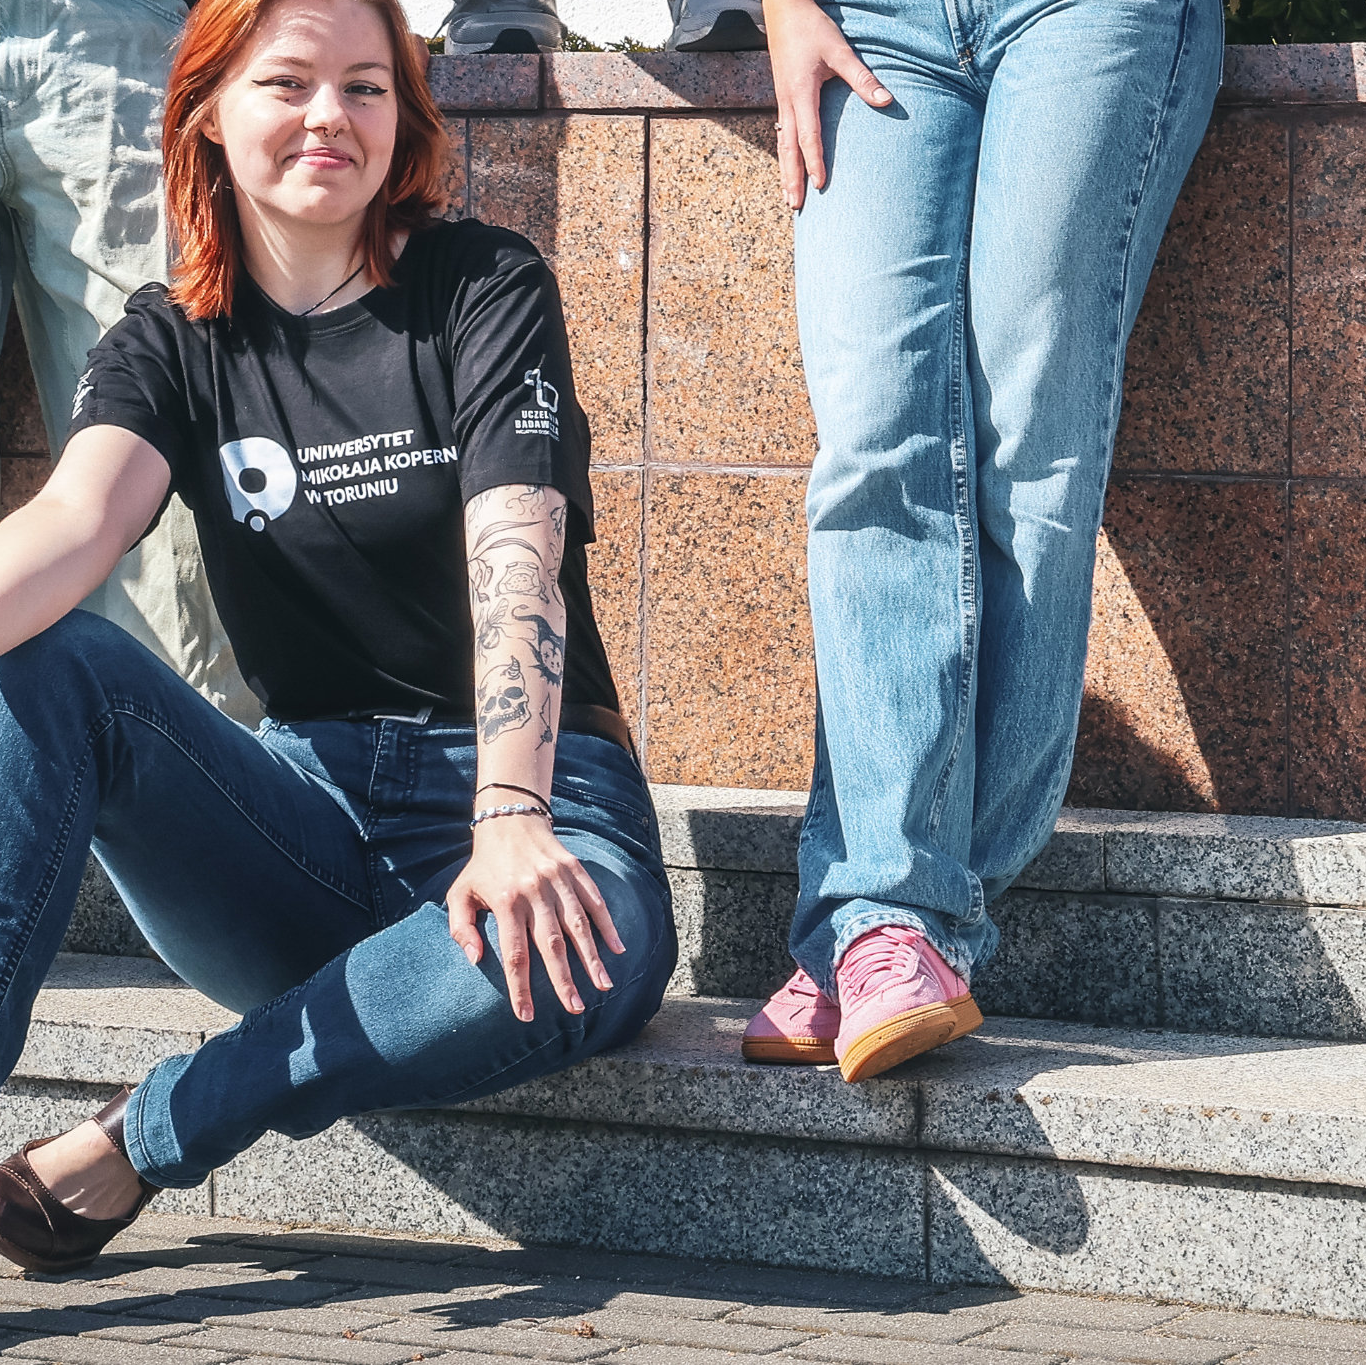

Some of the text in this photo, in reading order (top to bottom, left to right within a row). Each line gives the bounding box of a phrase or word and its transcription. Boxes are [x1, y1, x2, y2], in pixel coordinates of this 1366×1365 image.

[297, 429, 415, 463] UNIWERSYTET
[301, 445, 459, 485] MIKOŁAJA KOPERN
[304, 477, 399, 507] W TORUNIU
